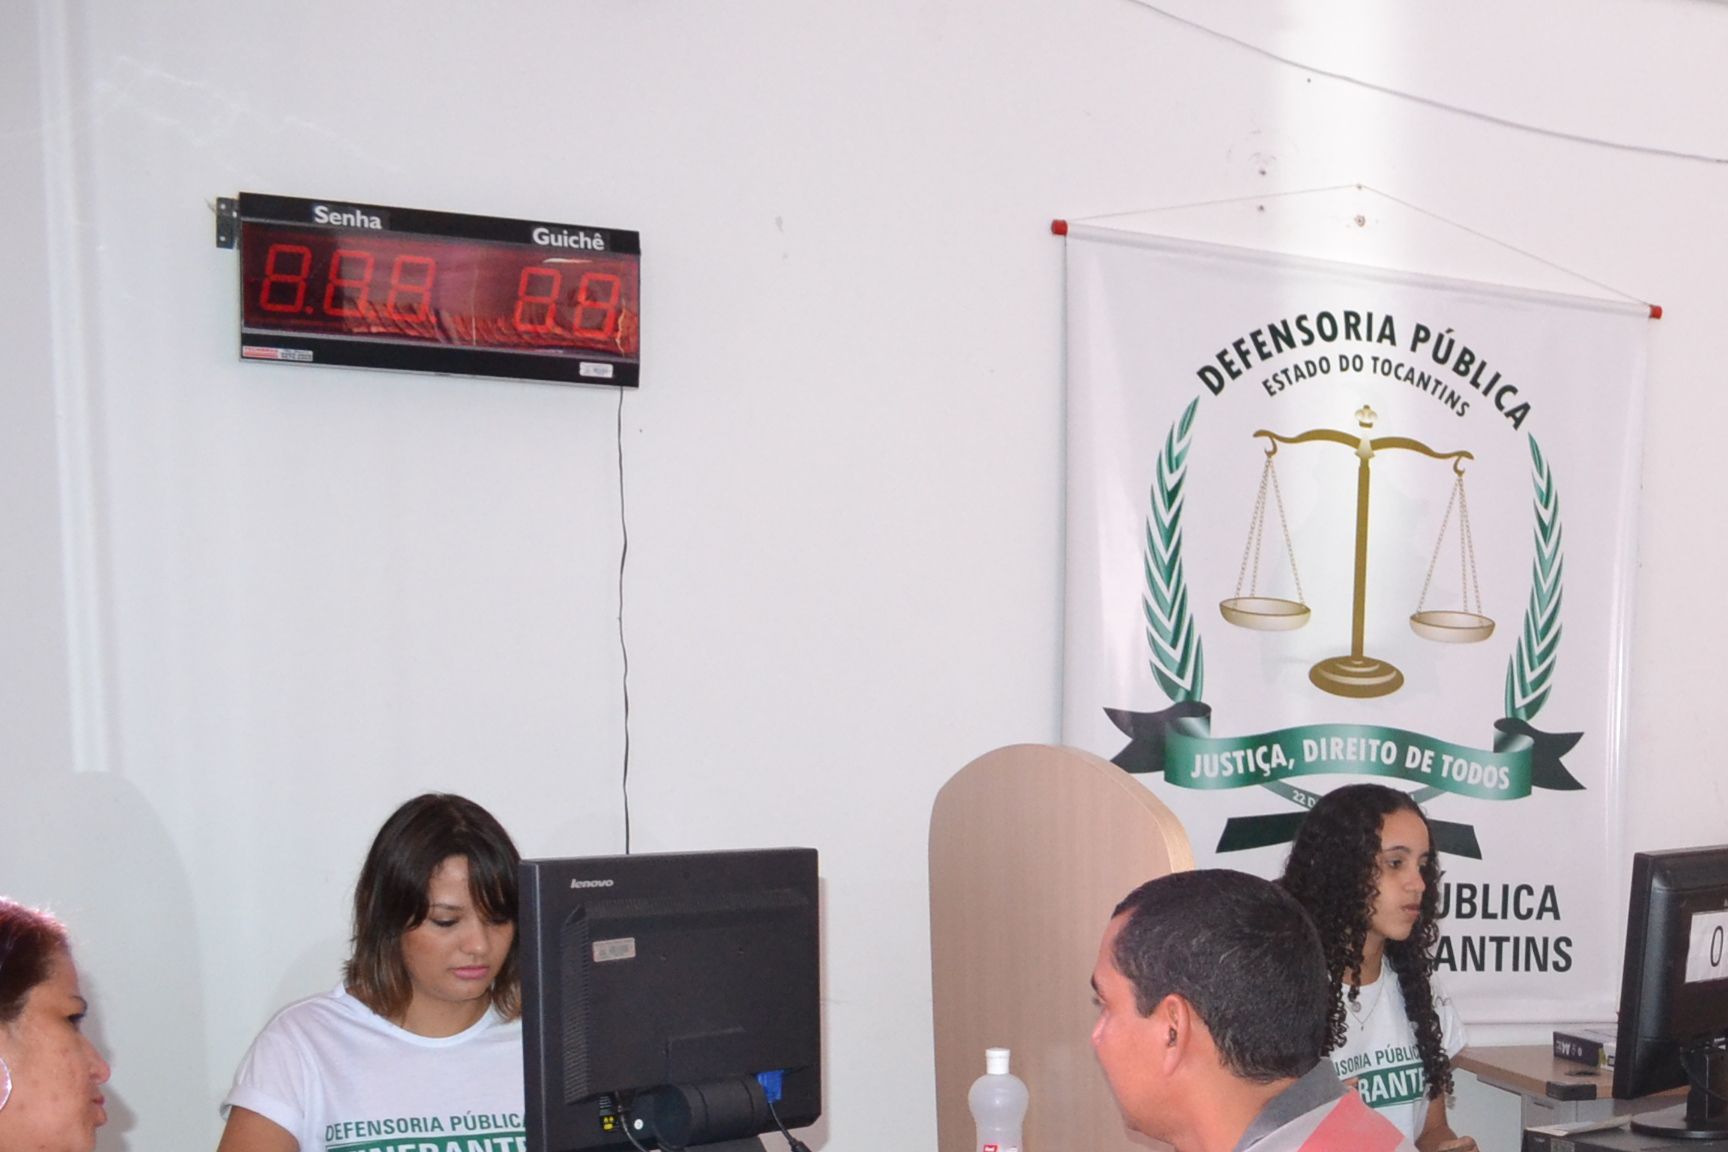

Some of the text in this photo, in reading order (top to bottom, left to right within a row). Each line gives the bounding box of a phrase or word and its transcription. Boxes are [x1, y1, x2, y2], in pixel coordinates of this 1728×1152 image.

[314, 205, 382, 230] Senha
[532, 227, 605, 250] Guichê
[1197, 310, 1531, 430] DEFENSORIA PÚBLICA
[1262, 354, 1470, 417] ESTADO DO TOCANTINS
[1190, 737, 1510, 790] JUSTIÇA, DIREITO DE TODOS
[1292, 789, 1306, 806] 22
[570, 878, 614, 889] lenovo
[325, 1110, 526, 1142] DEFENSORIA PÚBLIC
